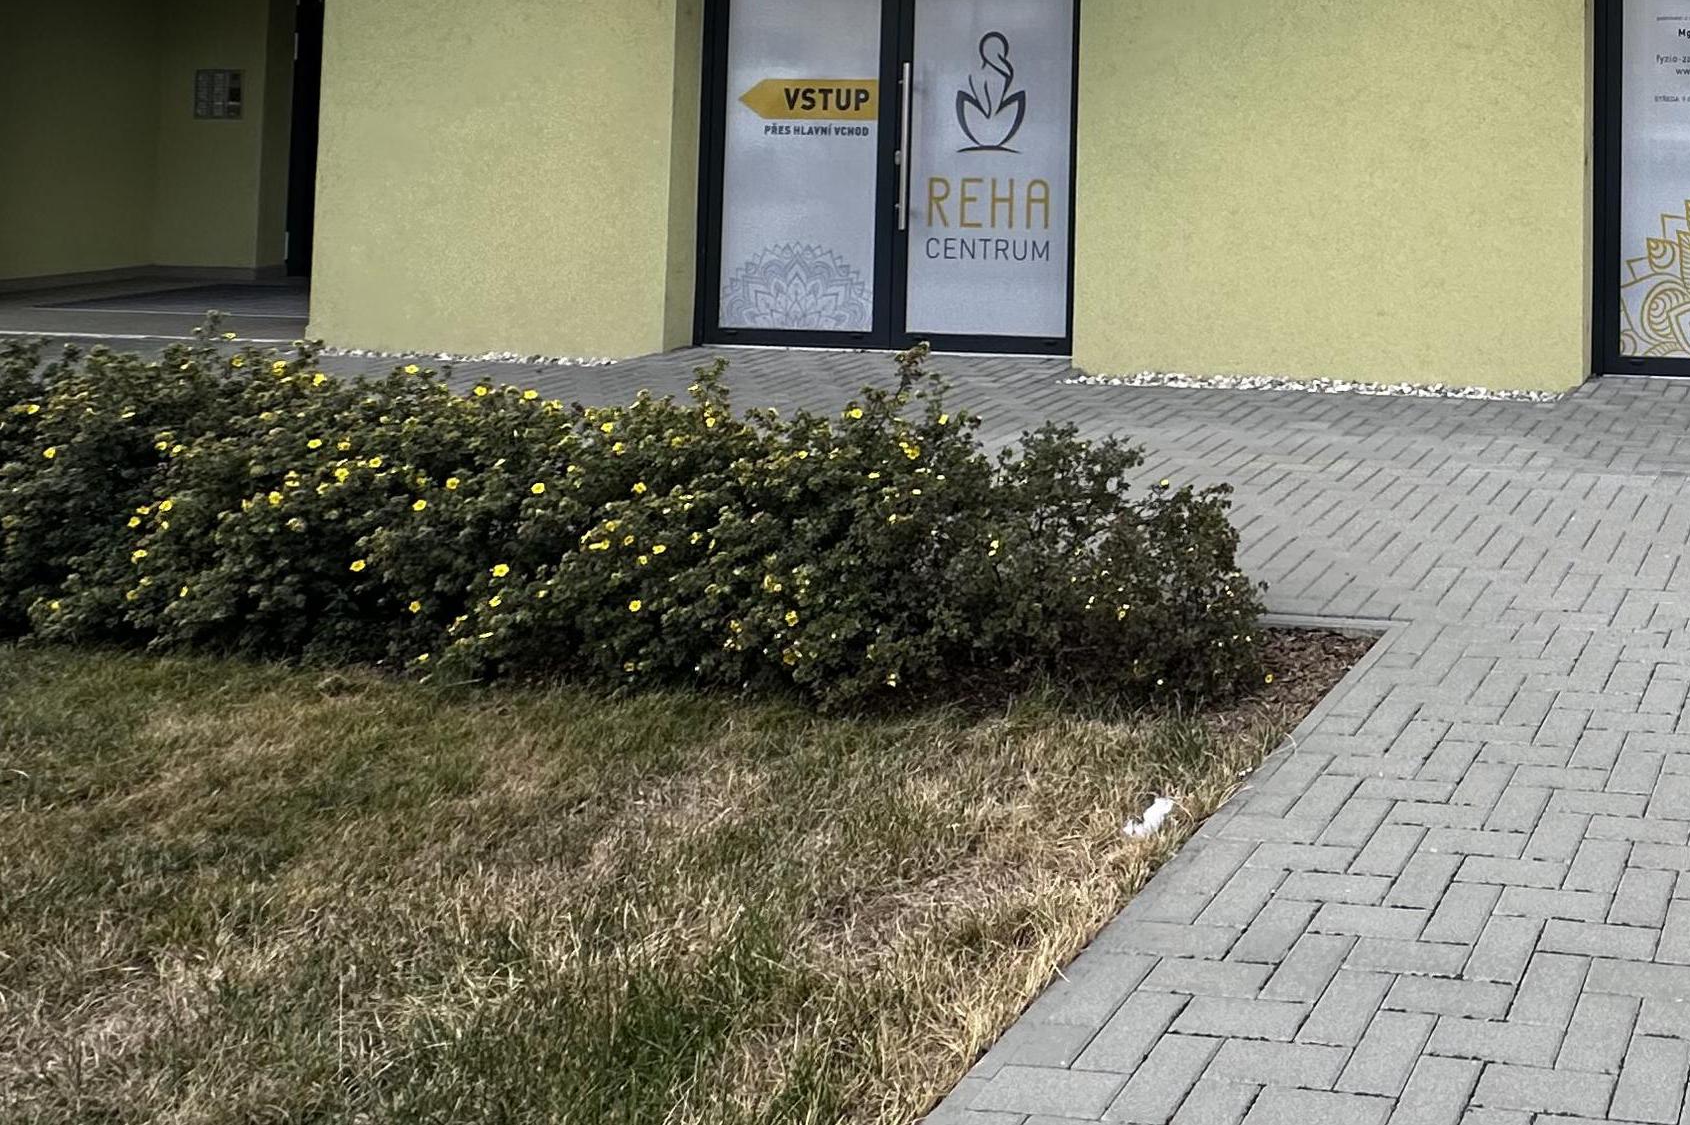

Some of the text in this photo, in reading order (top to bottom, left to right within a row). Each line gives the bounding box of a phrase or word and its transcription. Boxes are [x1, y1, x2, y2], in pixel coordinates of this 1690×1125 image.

[784, 87, 870, 112] VSTUP
[764, 122, 869, 137] PŘES HLAVNÍ VCHOD
[926, 177, 1050, 230] REHA
[925, 236, 1050, 262] CENTRUM
